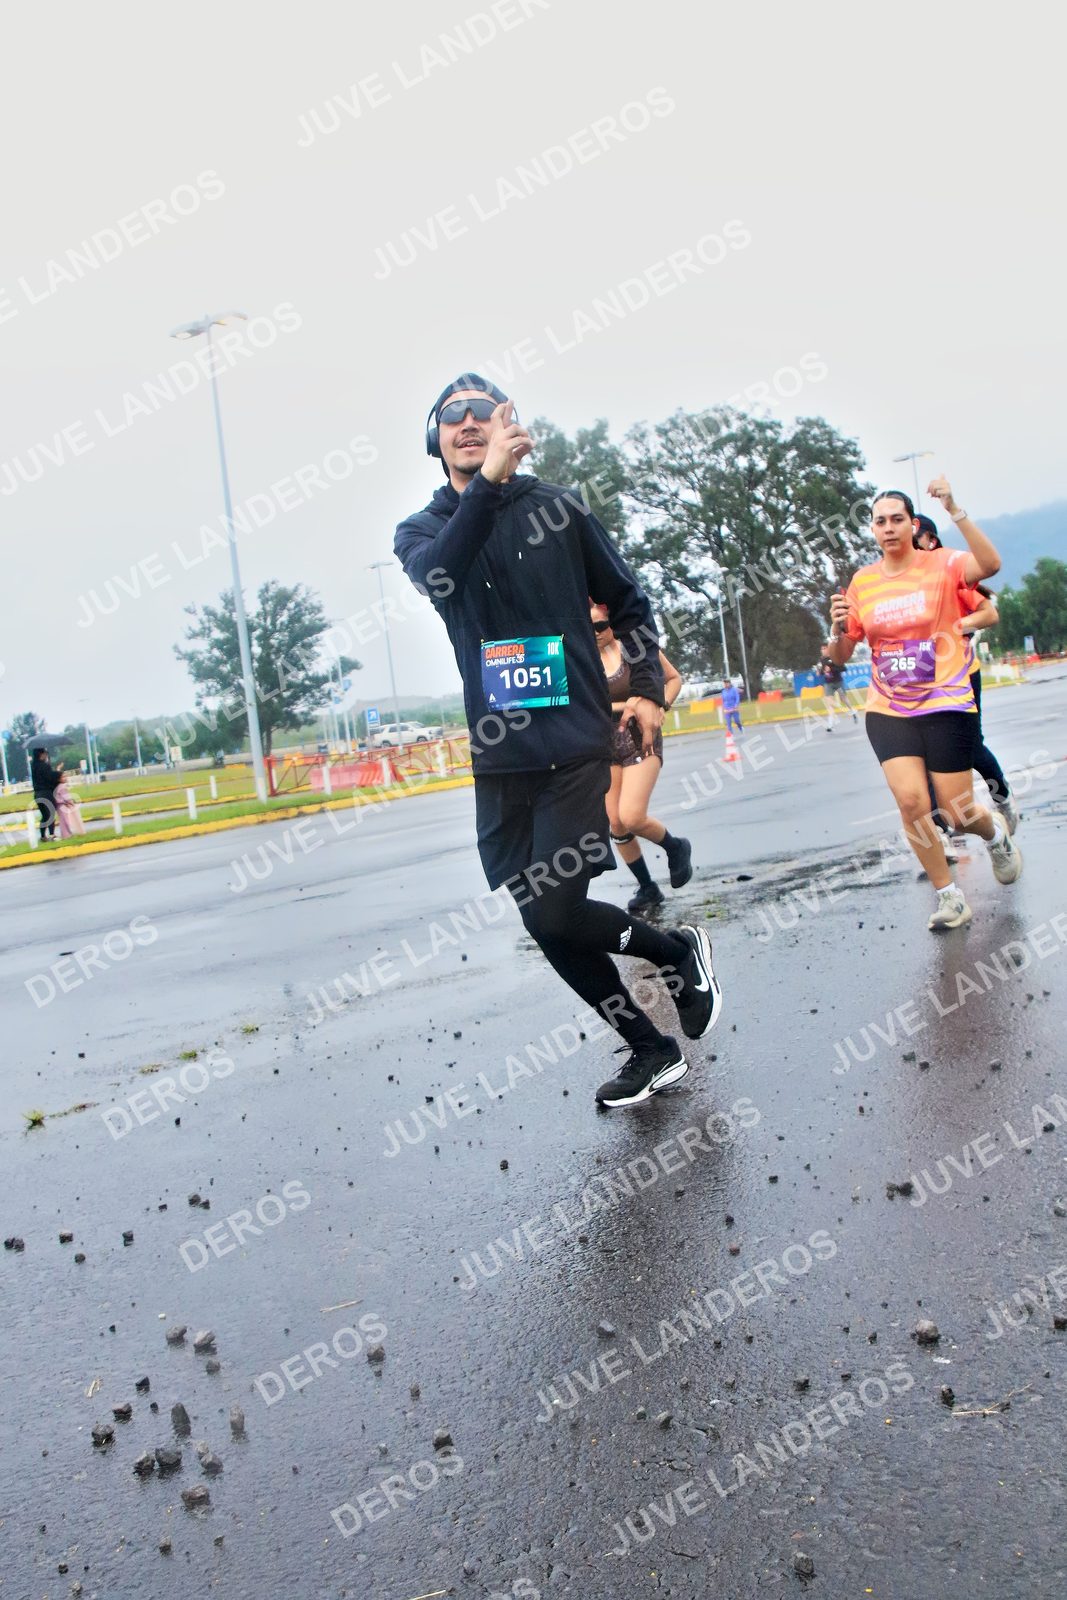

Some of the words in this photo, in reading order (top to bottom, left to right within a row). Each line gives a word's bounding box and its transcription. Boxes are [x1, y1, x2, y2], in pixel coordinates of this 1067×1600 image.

[485, 644, 524, 659] CARRERA
[547, 642, 559, 655] 10K
[891, 657, 916, 671] 265
[500, 666, 551, 689] 1051
